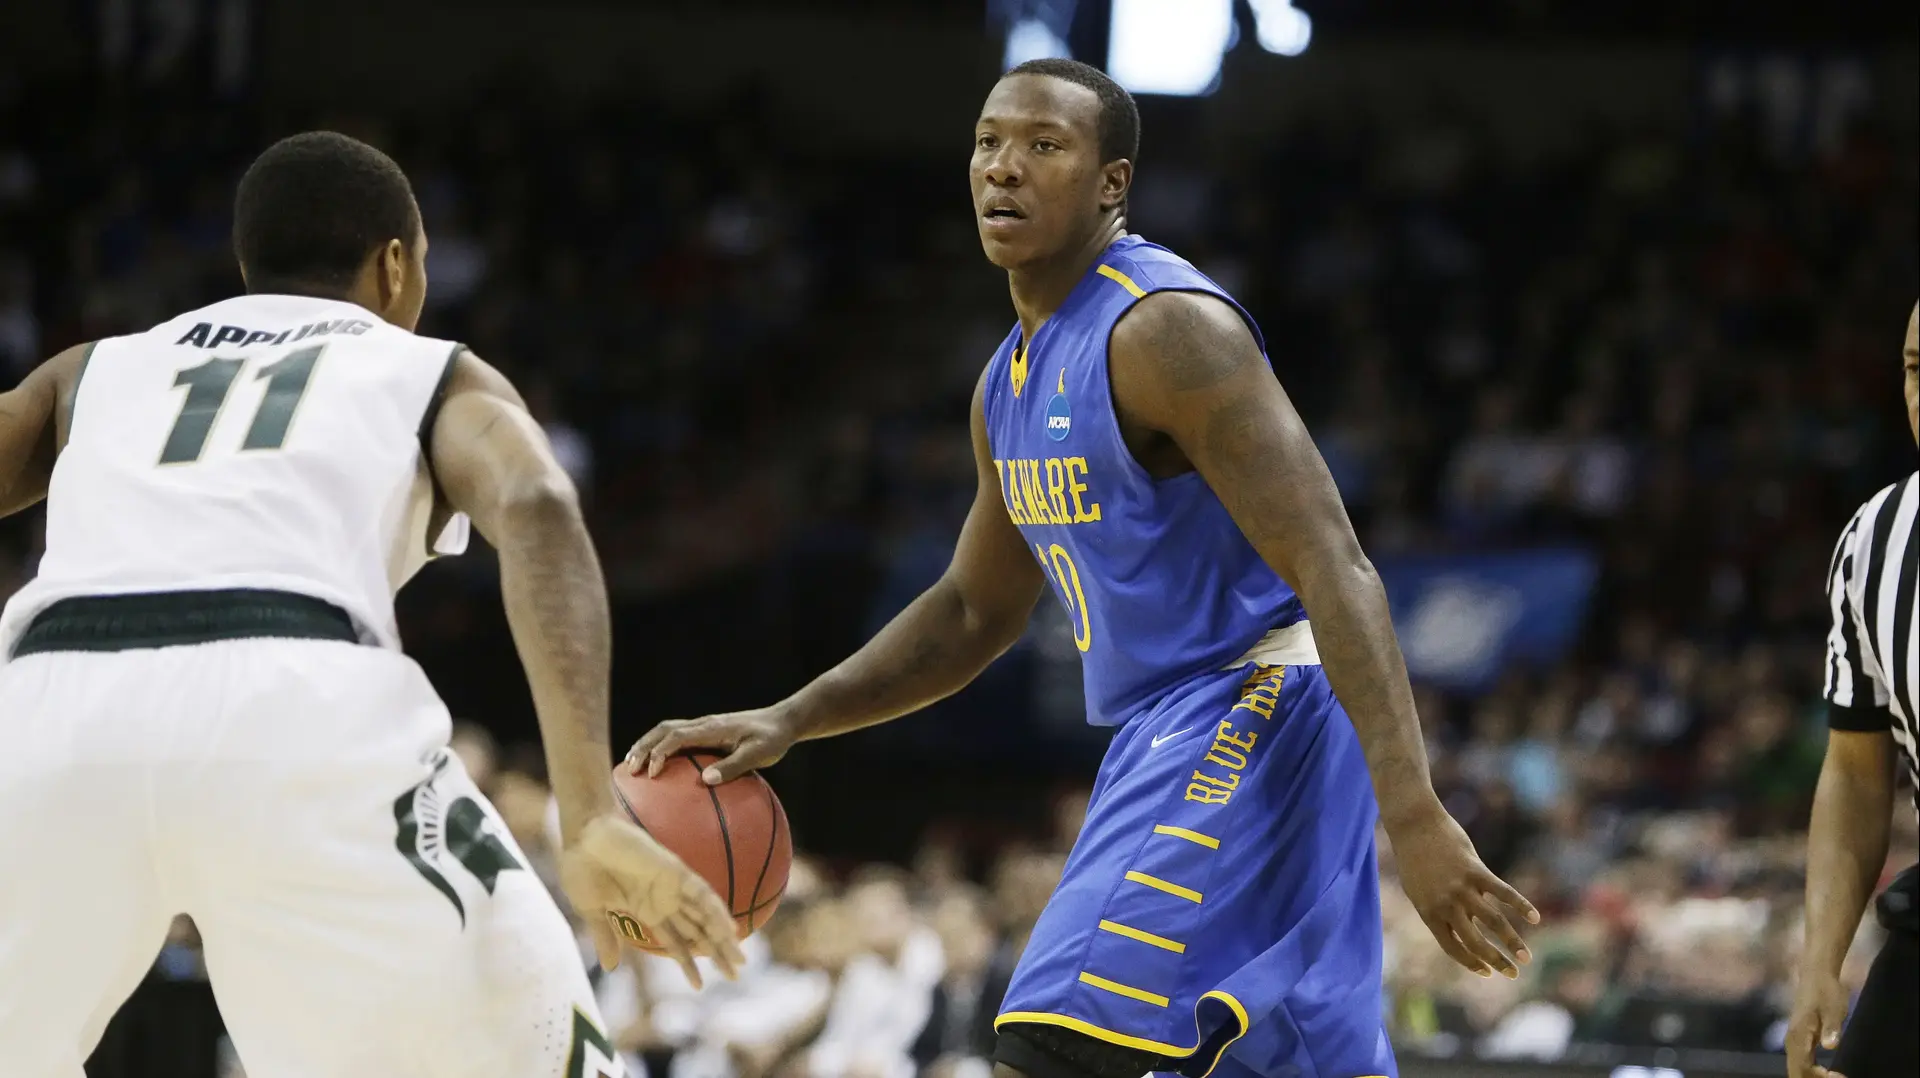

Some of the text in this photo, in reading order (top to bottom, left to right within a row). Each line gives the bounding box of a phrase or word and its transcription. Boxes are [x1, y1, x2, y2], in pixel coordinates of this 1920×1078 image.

[156, 342, 330, 468] 11
[1048, 416, 1070, 429] NCAA
[1184, 720, 1258, 805] BLUE
